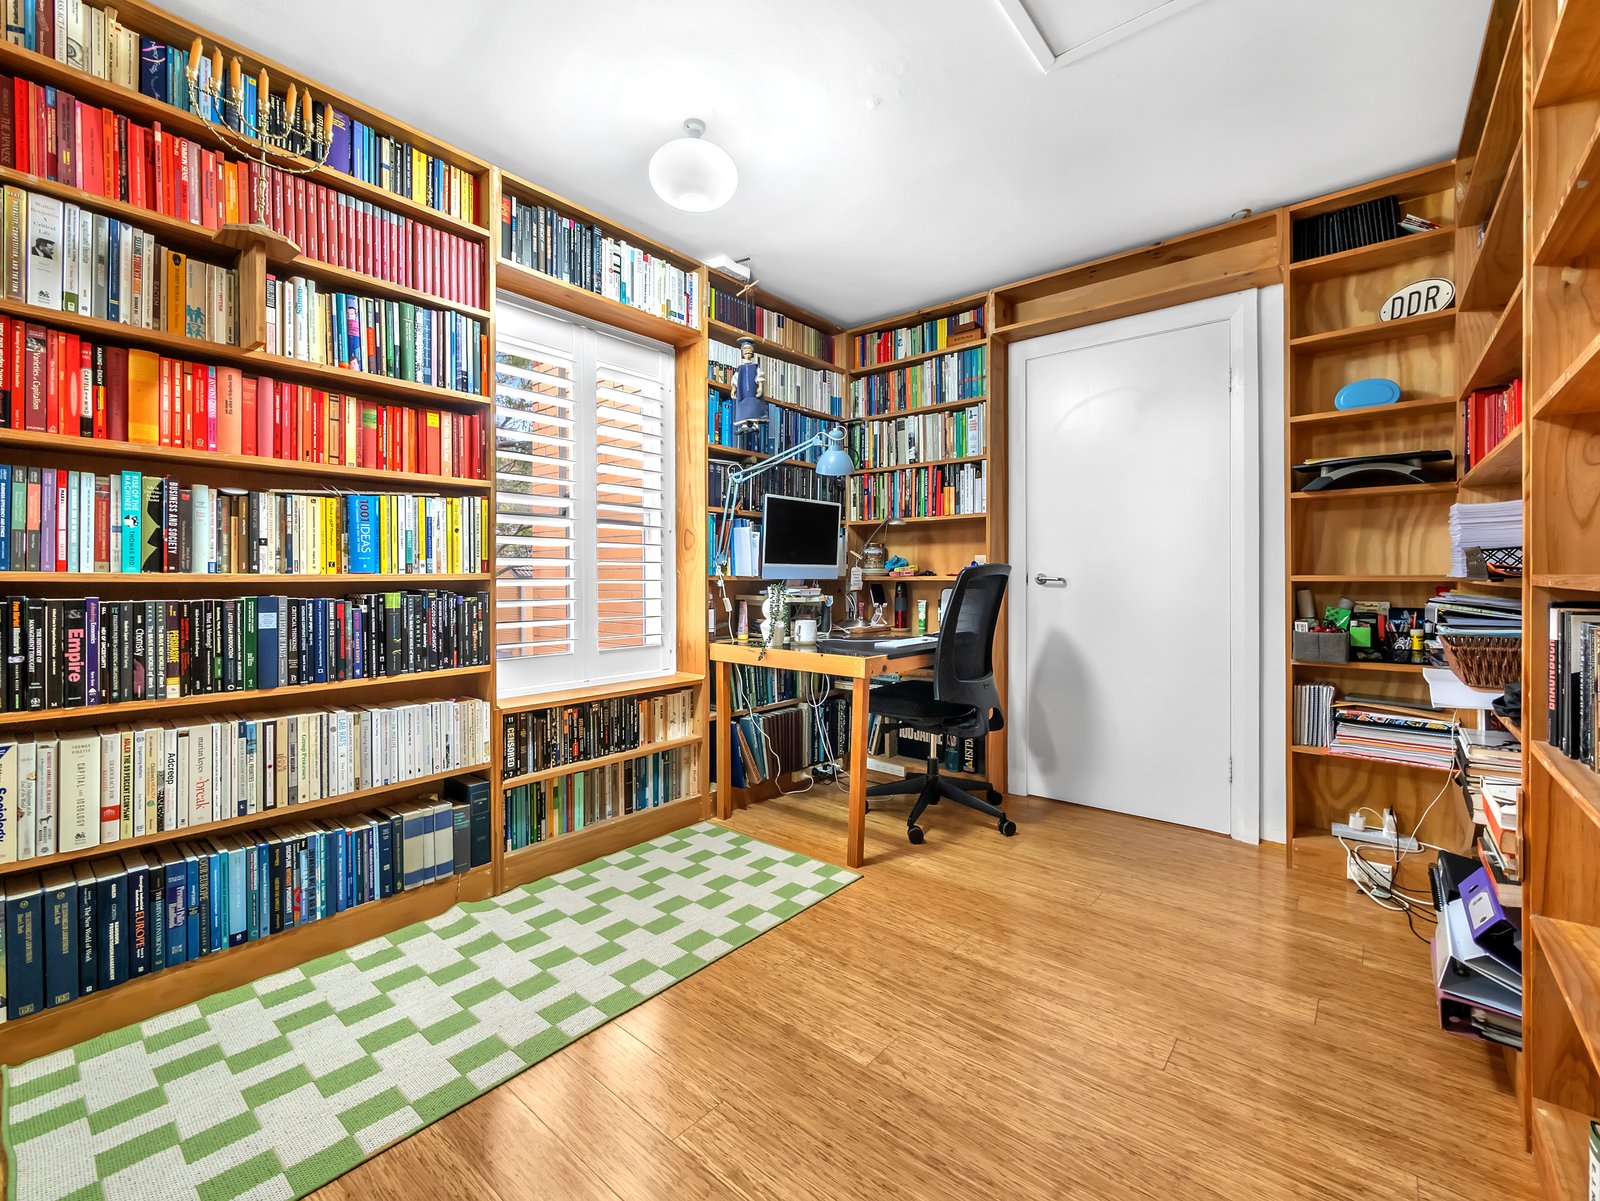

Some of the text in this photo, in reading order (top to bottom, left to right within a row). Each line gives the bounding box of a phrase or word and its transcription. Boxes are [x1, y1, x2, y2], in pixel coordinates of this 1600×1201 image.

[1390, 285, 1440, 320] DDR
[32, 352, 41, 410] Varieties Capitalism
[208, 399, 216, 418] GIDDENS
[132, 490, 138, 499] OF
[168, 482, 178, 554] BUSINESS AND SOCIETY
[359, 500, 371, 553] 1001 IDEAS
[64, 628, 84, 682] Empire
[134, 628, 144, 657] Chomsky
[169, 630, 179, 662] PERSUASIVE
[914, 731, 943, 745] JAHE
[965, 738, 973, 761] GLISH
[166, 752, 175, 785] Adcreep
[77, 763, 85, 827] CAPITAL IDEOLOGY
[196, 778, 209, 809] break
[135, 911, 144, 949] EUROPE
[177, 911, 185, 926] Policy
